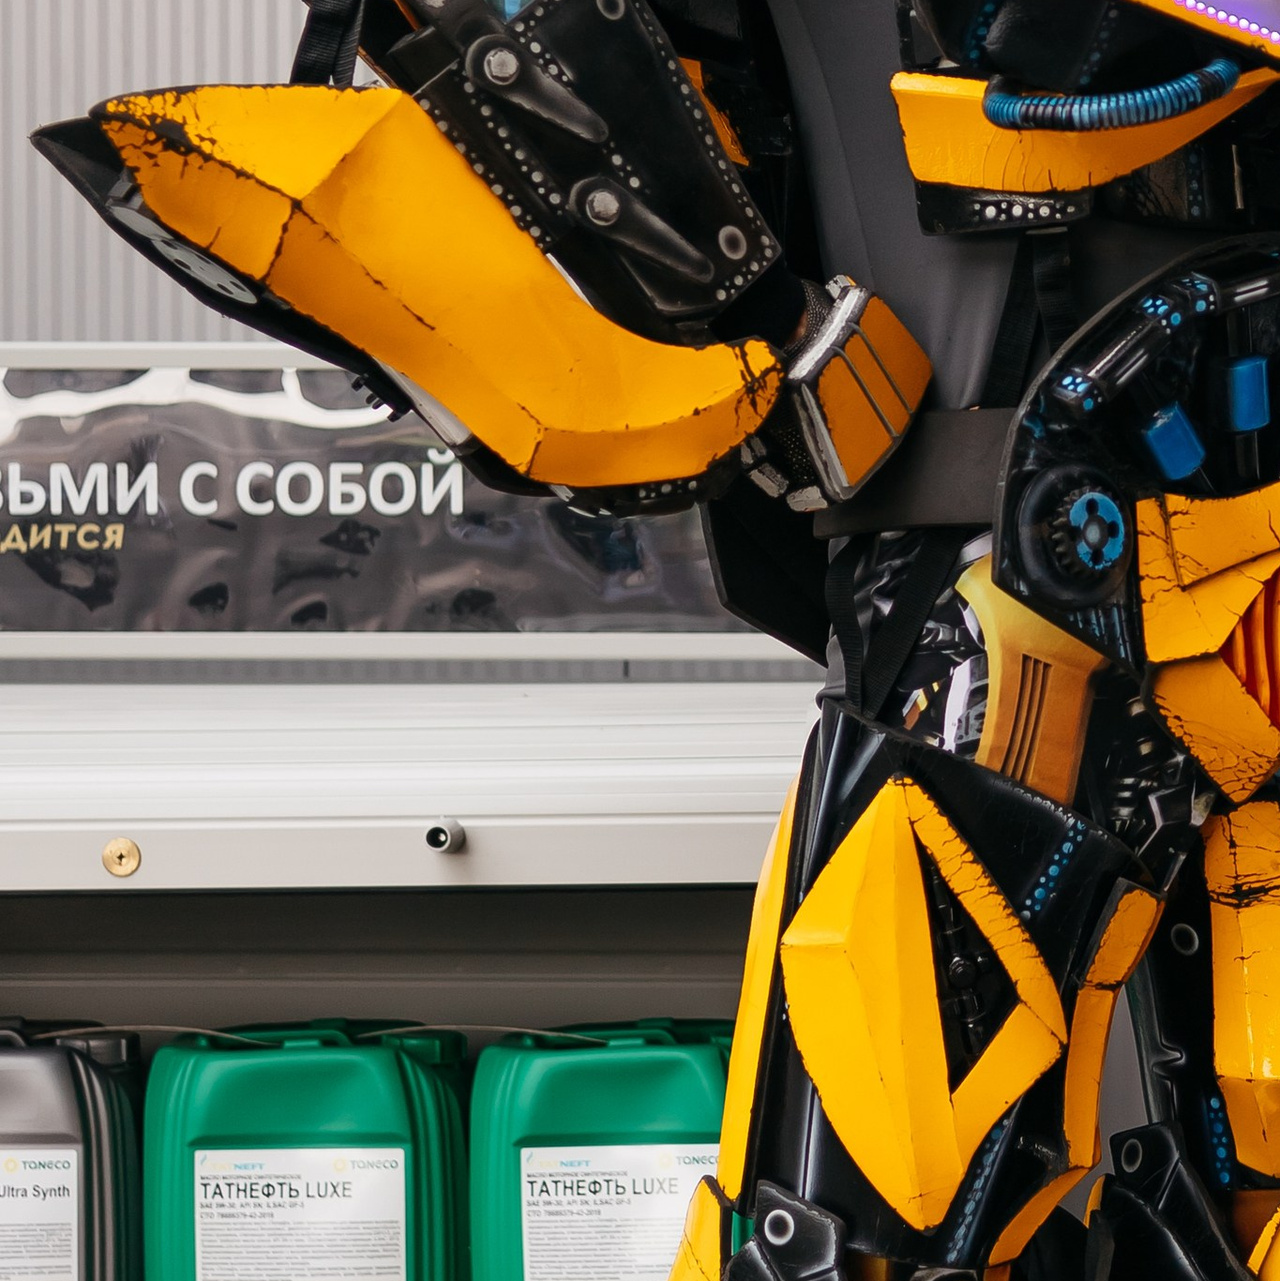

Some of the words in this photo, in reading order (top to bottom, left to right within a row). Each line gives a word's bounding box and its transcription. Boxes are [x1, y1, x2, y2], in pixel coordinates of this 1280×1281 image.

[0, 462, 158, 516] ЬМИ
[179, 461, 218, 516] С
[236, 448, 463, 516] СОБОЙ
[32, 1184, 71, 1201] Synth
[200, 1182, 300, 1199] ТАТНЕФТЬ
[306, 1181, 352, 1198] LUXE
[527, 1179, 627, 1197] ТАТНЕФТЬ
[632, 1177, 679, 1195] LUXE
